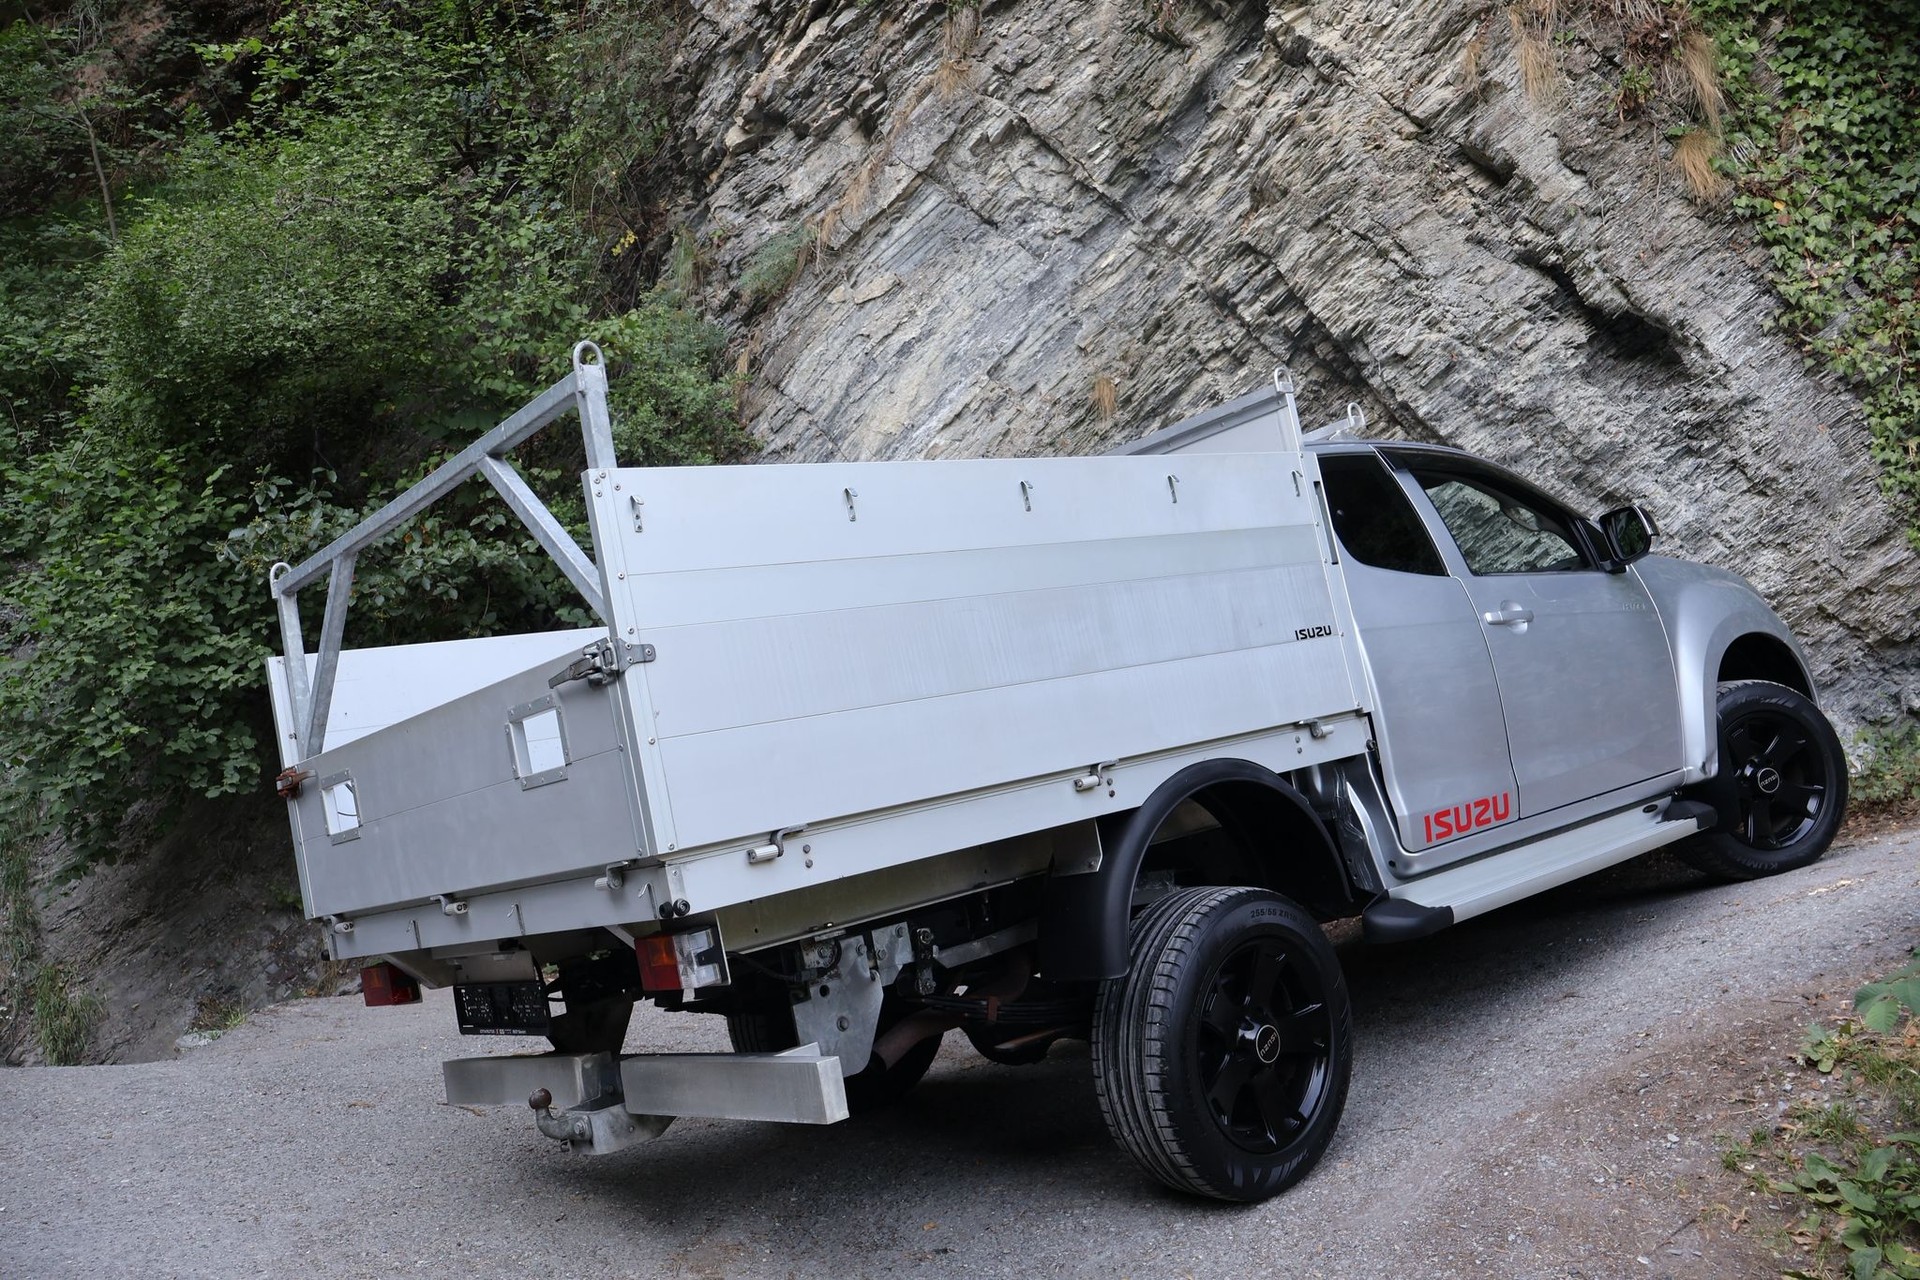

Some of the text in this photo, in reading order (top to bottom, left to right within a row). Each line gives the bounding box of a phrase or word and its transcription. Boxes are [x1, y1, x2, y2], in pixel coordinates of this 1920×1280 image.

[1294, 624, 1332, 641] ISUZU
[1423, 792, 1510, 844] ISUZU
[1260, 1031, 1277, 1057] ISUZU
